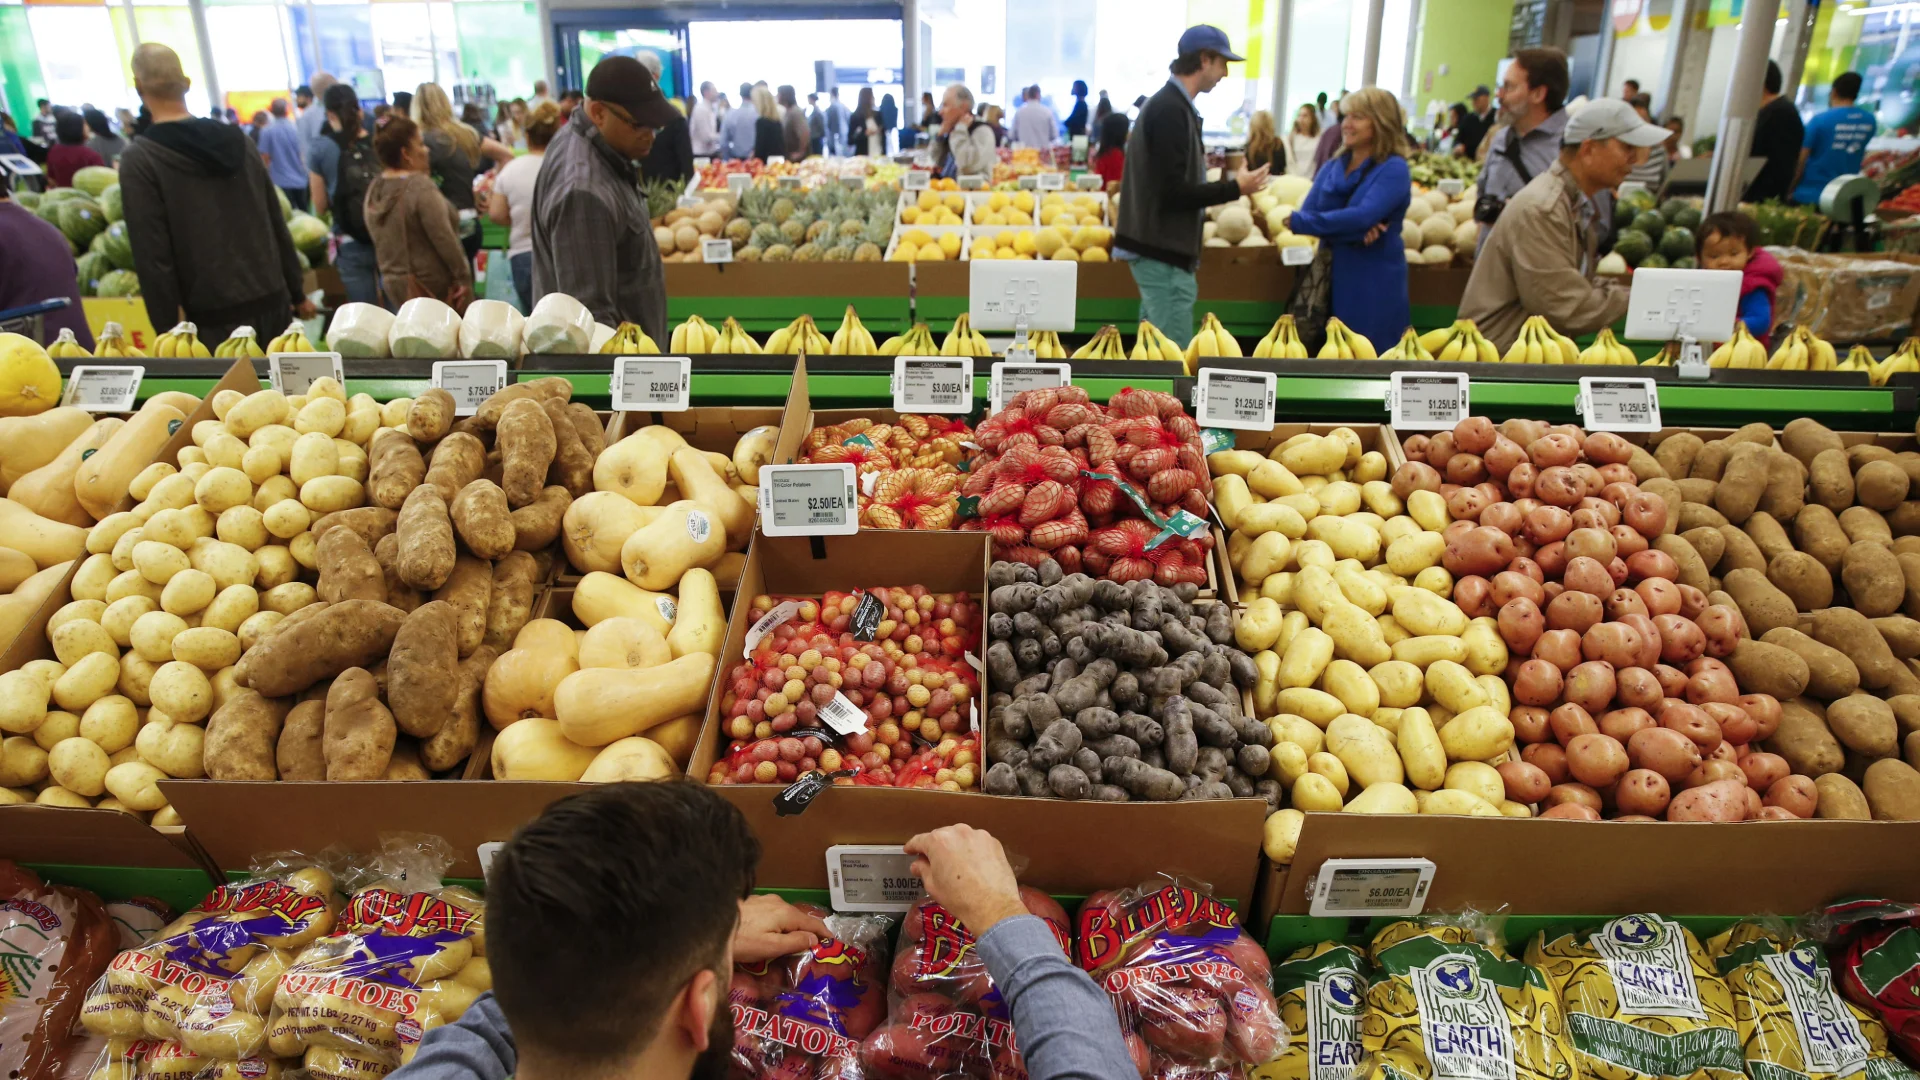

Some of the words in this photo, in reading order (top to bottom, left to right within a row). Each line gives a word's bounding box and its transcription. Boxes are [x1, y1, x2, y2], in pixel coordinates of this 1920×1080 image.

[468, 385, 496, 396] $.75/LB
[650, 382, 679, 392] $2.00/EA
[932, 383, 962, 393] $3.00/EA
[1235, 397, 1264, 410] $1.25/LB
[1428, 399, 1457, 409] $1.25/LB
[1619, 403, 1648, 412] $1.25/LB
[807, 497, 844, 510] $2.50/EA
[882, 878, 924, 889] $3.00/EA
[1369, 887, 1410, 897] $6.00/EA
[1078, 885, 1238, 976] BLUEJAY
[1618, 962, 1688, 998] EARTH
[279, 973, 420, 1016] POTATOES
[312, 1007, 319, 1018] 5
[341, 1013, 363, 1027] 2.27
[365, 1018, 378, 1032] kg
[1319, 1007, 1363, 1042] HONE
[729, 1003, 860, 1058] OTATOES
[1571, 1014, 1621, 1042] CERTIFIED
[1622, 1028, 1667, 1057] ORGANIC
[1670, 1030, 1710, 1060] YELLOW
[367, 1037, 381, 1047] CA
[1433, 1023, 1503, 1057] EARTH
[1318, 1041, 1364, 1066] EART
[362, 1060, 378, 1073] WT.
[381, 1065, 389, 1074] 5
[1437, 1055, 1474, 1073] ORGANIC
